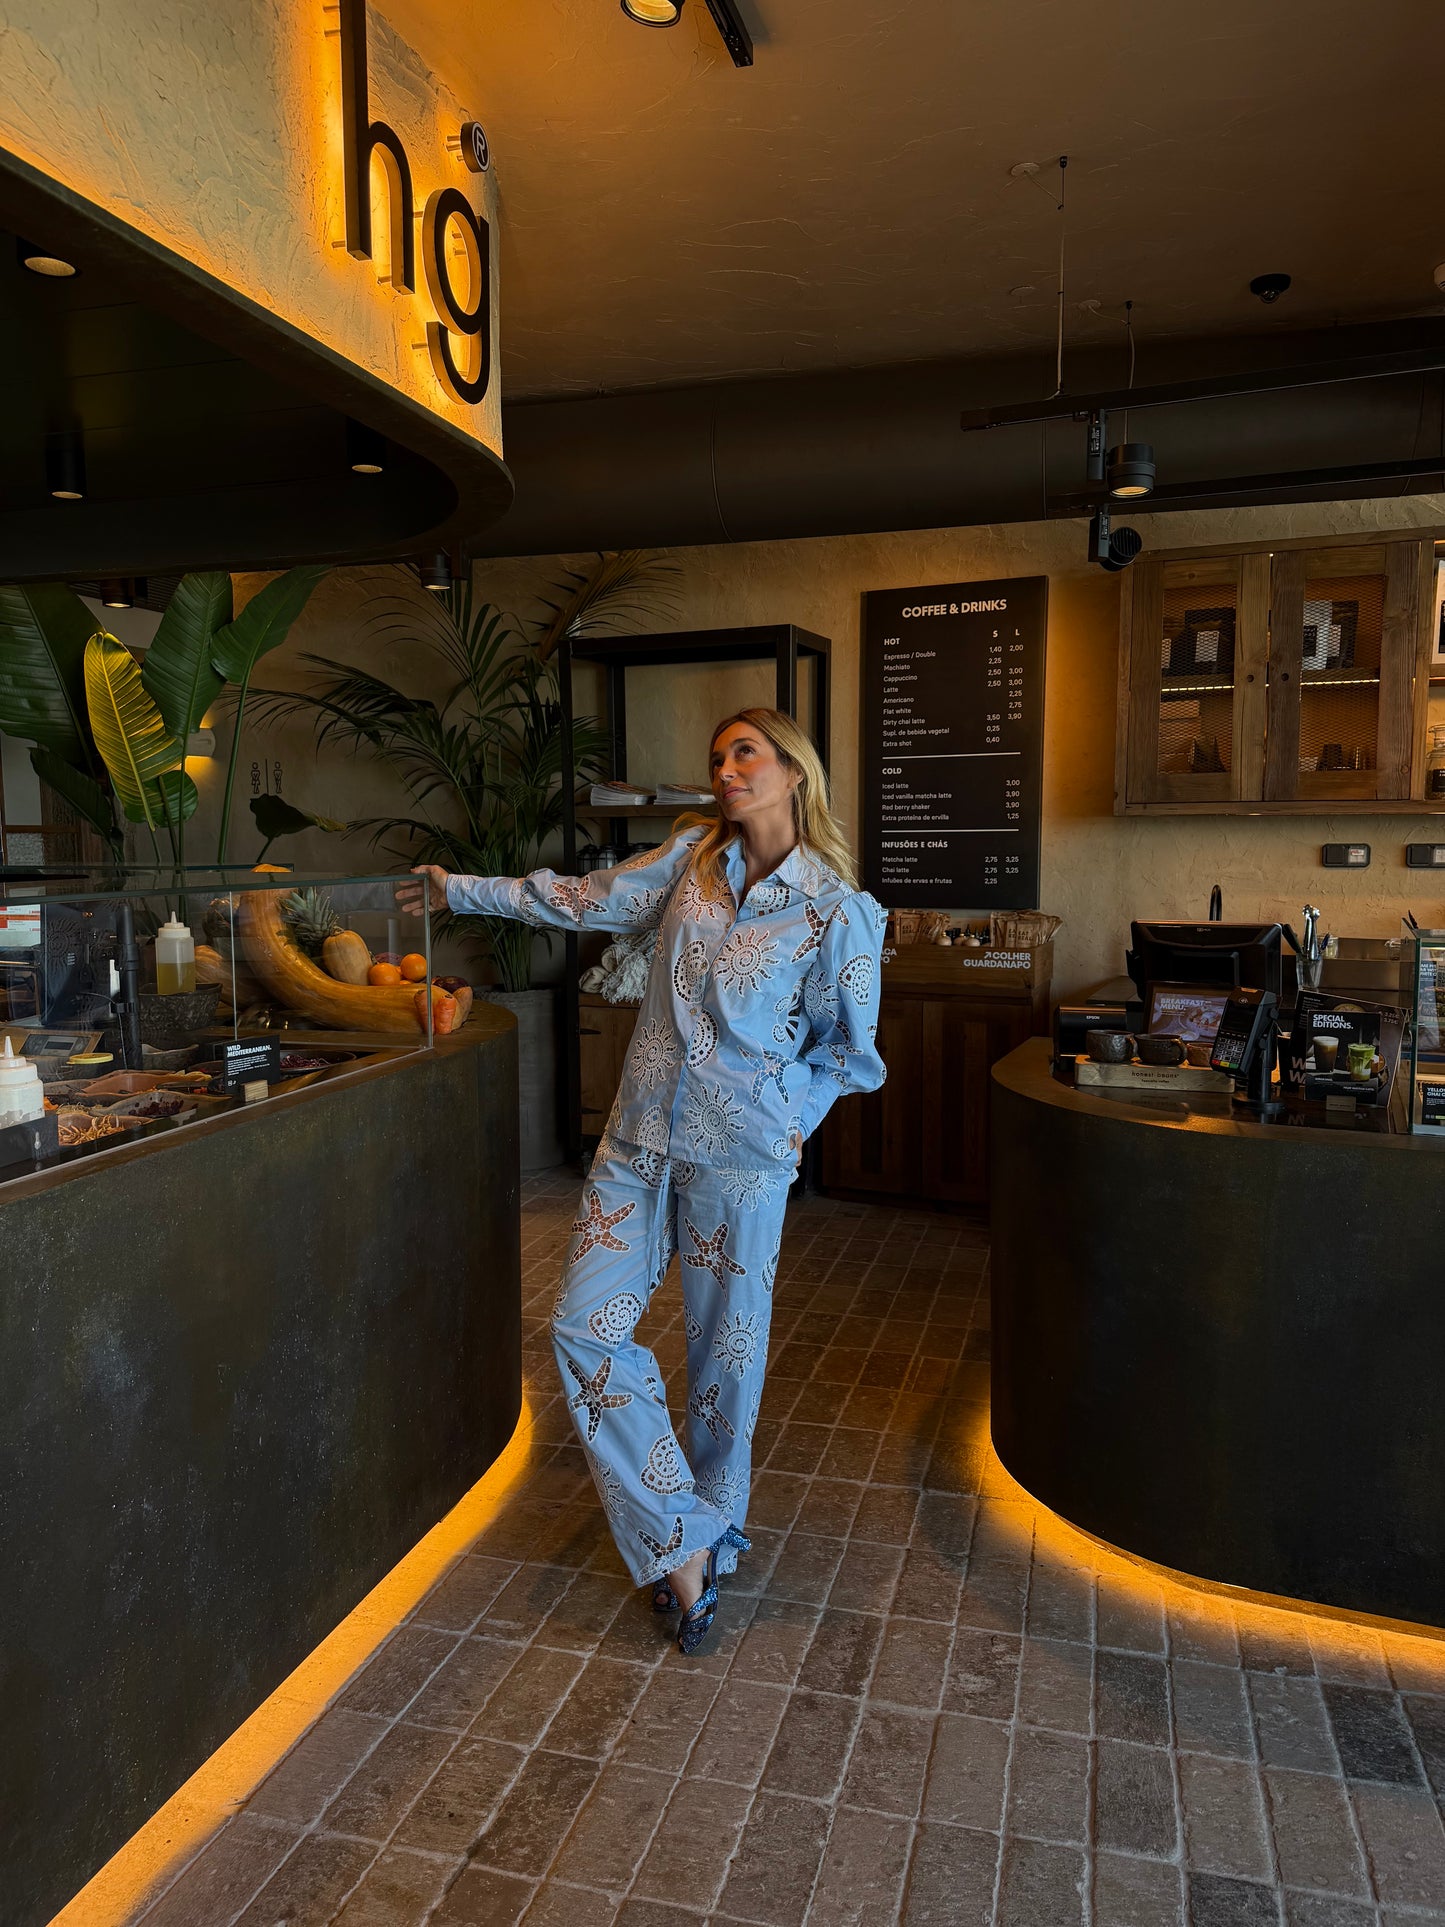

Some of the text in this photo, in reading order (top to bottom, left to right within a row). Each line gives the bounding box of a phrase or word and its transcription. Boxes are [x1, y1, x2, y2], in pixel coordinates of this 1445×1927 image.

[902, 599, 1007, 618] COFFEE & DRINKS
[884, 628, 1020, 646] HOT S L
[884, 653, 910, 661] Espresso
[989, 646, 1002, 654] 1,40
[1009, 644, 1024, 652] 2,00
[988, 657, 1002, 665] 2,25
[883, 667, 1023, 683] Cappuccino 2,50 3,00
[1008, 678, 1023, 686] 3,00
[1008, 690, 1023, 698] 2,25
[1008, 701, 1023, 709] 2,75
[928, 728, 950, 736] vegetal
[985, 736, 1000, 744] 0,40
[882, 767, 902, 775] COLD
[1005, 779, 1020, 787] 3,00
[894, 804, 910, 812] berry
[881, 840, 918, 848] INFUSÕES
[927, 839, 948, 848] CHÁS
[992, 952, 1031, 961] COLHER
[963, 959, 1031, 969] GUARDANAPO
[1160, 998, 1205, 1006] BREAKFAST
[1160, 1003, 1186, 1011] MENU.
[1313, 1014, 1345, 1022] SPECIAL
[1313, 1021, 1354, 1029] EDITIONS.
[227, 1044, 241, 1052] WILD
[227, 1044, 272, 1058] MEDITERRANEAN.
